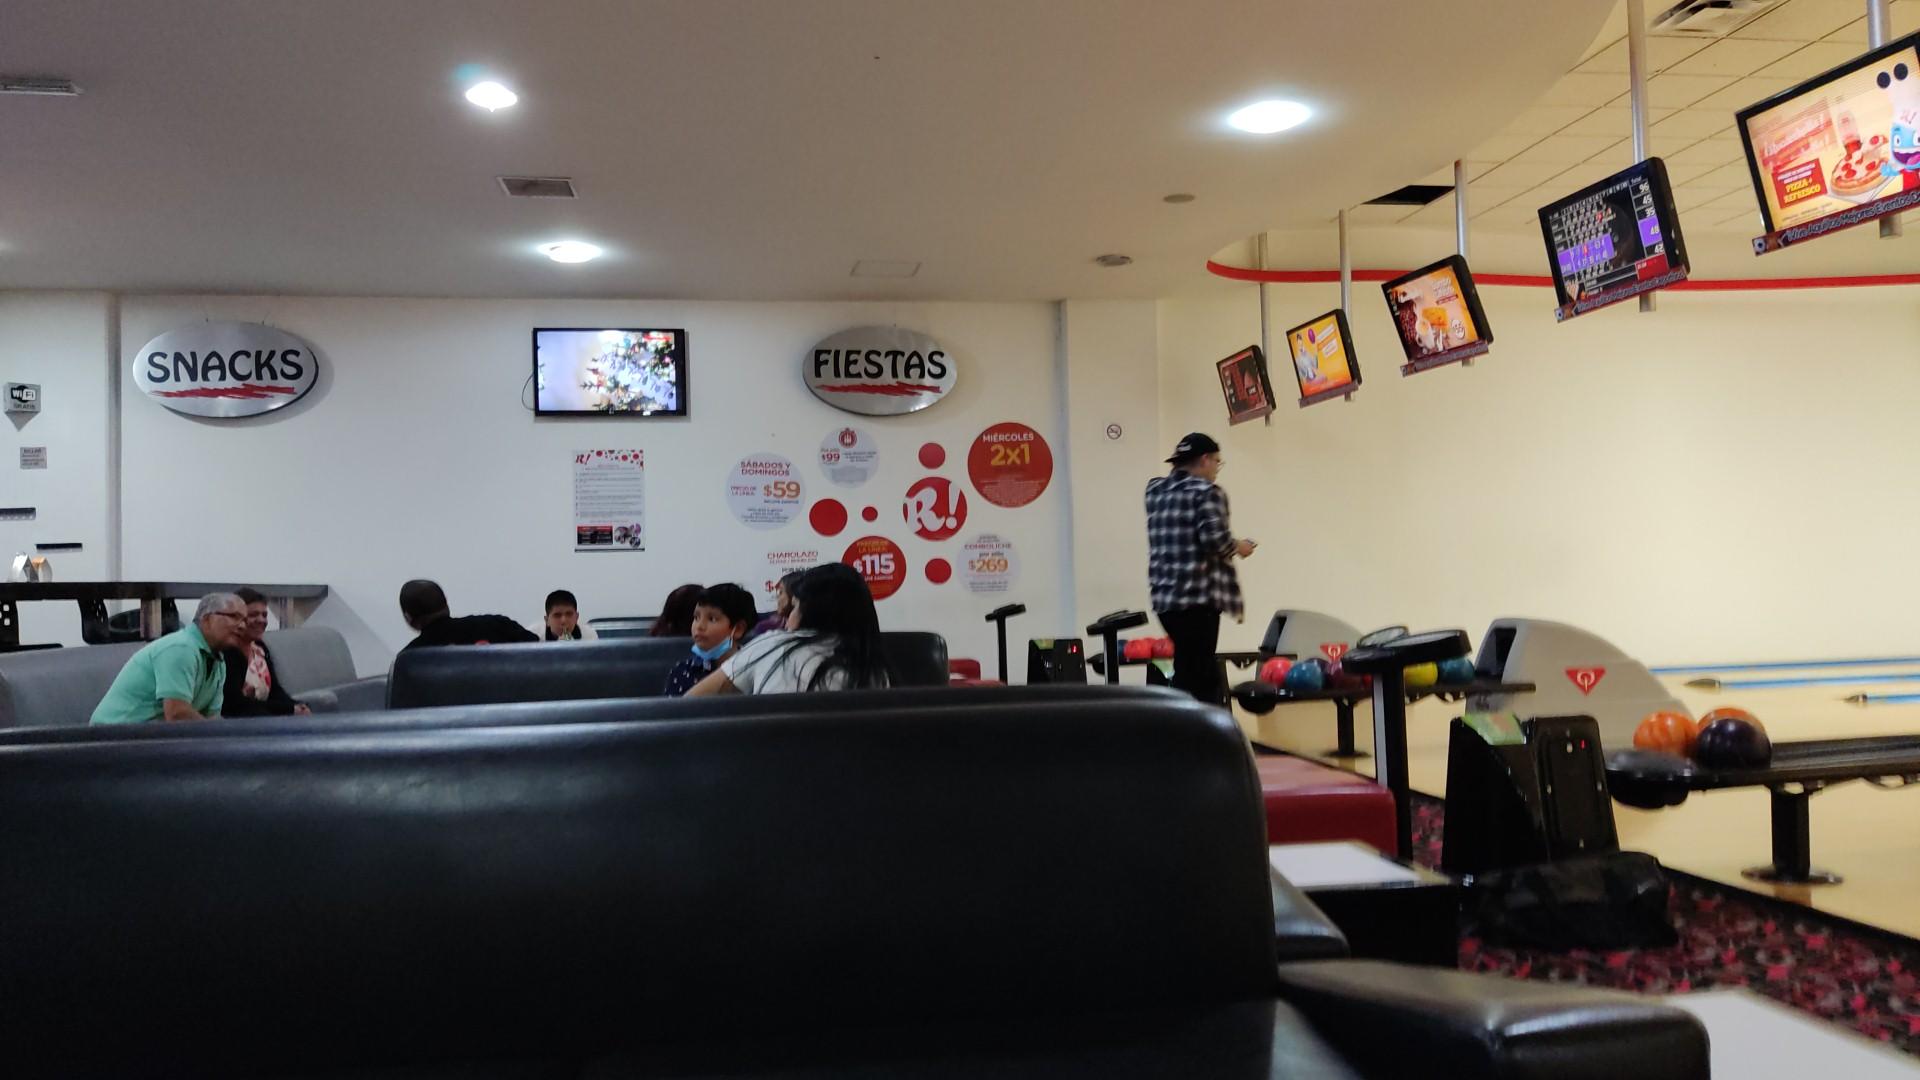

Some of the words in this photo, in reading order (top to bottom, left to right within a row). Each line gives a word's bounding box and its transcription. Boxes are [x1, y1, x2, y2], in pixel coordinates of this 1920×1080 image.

[1838, 203, 1876, 226] Mejores
[147, 349, 304, 383] SNACKS
[814, 349, 947, 379] FIESTAS
[982, 432, 1034, 442] MIÉRCOLES
[740, 460, 783, 469] SÁBADOS
[822, 453, 840, 463] $99
[990, 442, 1031, 467] 2x1
[741, 469, 790, 477] DOMINGOS
[763, 480, 801, 499] $59
[905, 481, 961, 534] R!
[853, 553, 895, 576] $115
[968, 559, 1008, 573] $269
